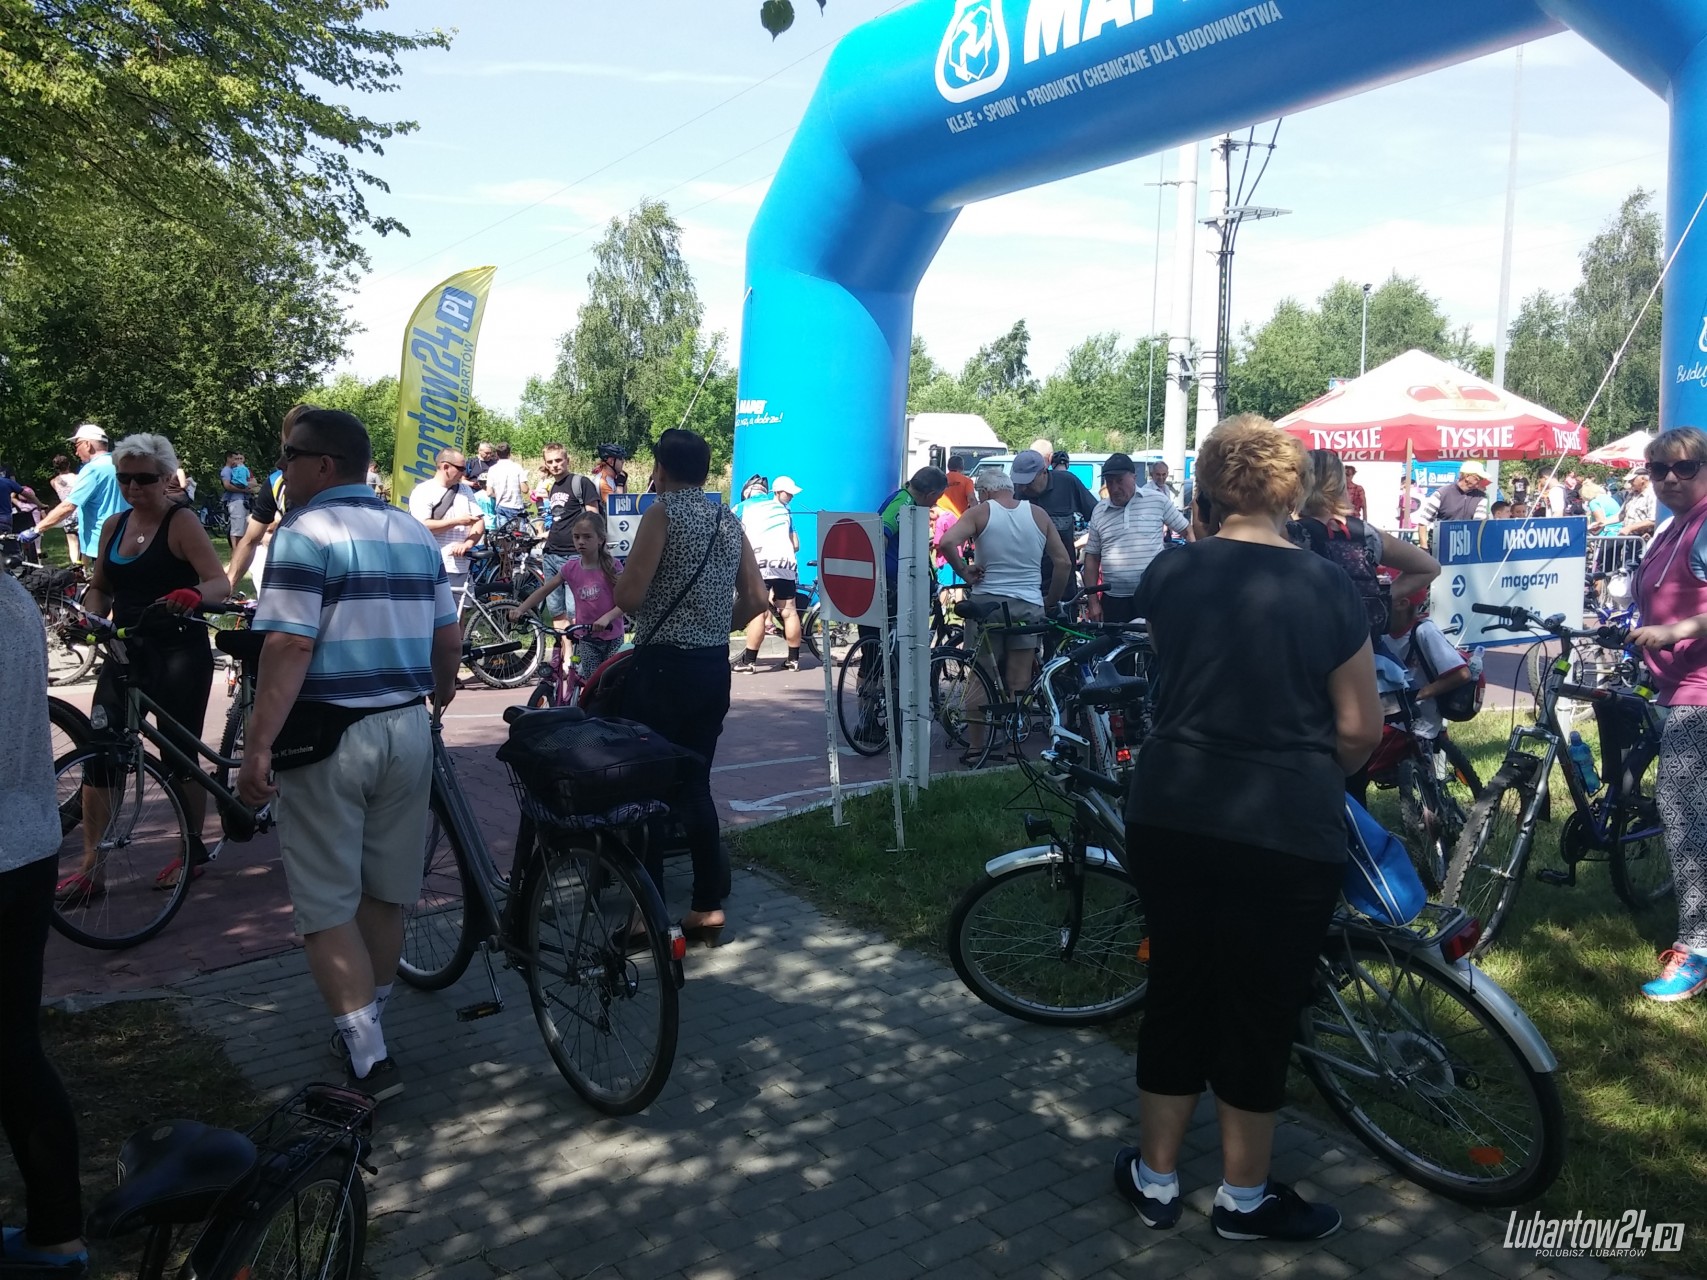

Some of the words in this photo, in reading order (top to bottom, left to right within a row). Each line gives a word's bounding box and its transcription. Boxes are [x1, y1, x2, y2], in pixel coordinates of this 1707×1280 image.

[946, 110, 978, 134] KLEJE
[982, 95, 1021, 122] SPOINY
[1026, 72, 1084, 107] PRODUKTY
[1083, 49, 1152, 88] CHEMICZNE
[1148, 38, 1180, 65] DLA
[1176, 0, 1283, 55] BUDOWNICTWA
[459, 339, 474, 413] LUBARTÓW
[1309, 426, 1383, 450] TYSKIE
[1436, 425, 1515, 448] TYSKIE
[615, 496, 631, 514] psb
[1449, 523, 1471, 562] psb
[1502, 522, 1571, 551] MRÓWKA
[1501, 572, 1559, 591] magazyn
